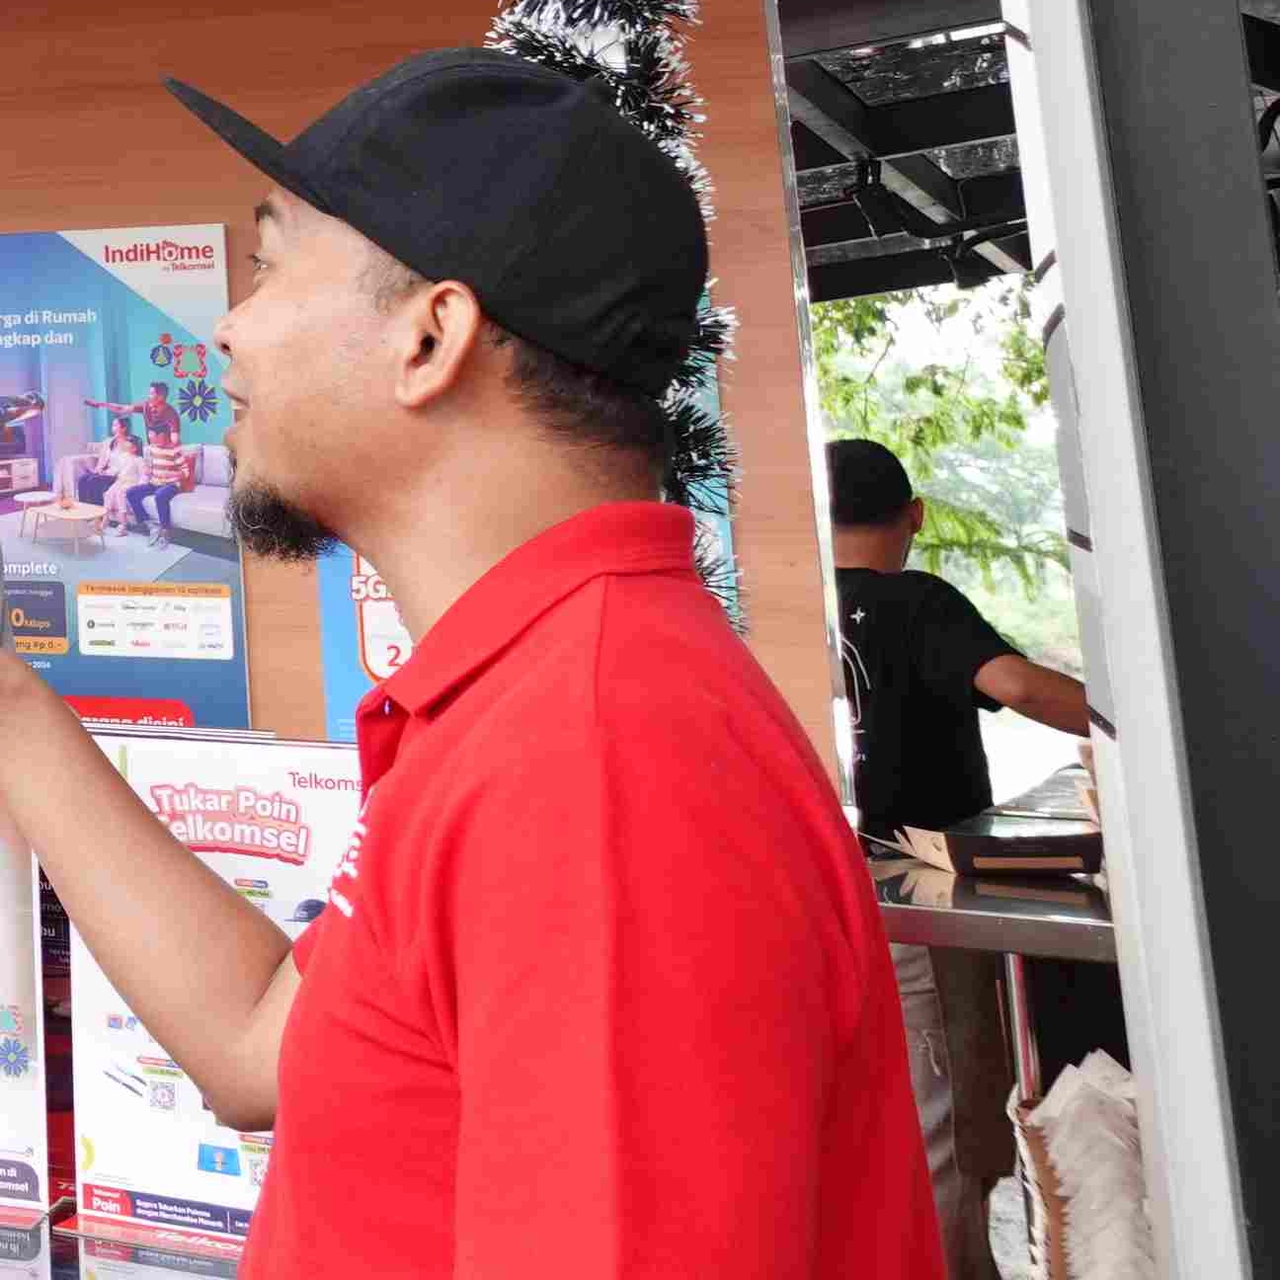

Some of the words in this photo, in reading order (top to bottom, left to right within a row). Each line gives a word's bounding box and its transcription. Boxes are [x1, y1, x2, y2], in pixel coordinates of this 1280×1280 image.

[104, 240, 214, 263] IndiHome
[24, 310, 39, 325] di
[42, 308, 97, 324] Rumah
[43, 329, 74, 345] dan
[288, 771, 364, 792] Telkoms
[154, 787, 230, 812] Tukar
[237, 791, 298, 823] Poin
[92, 1197, 120, 1214] Poin
[157, 1231, 244, 1251] Telko
